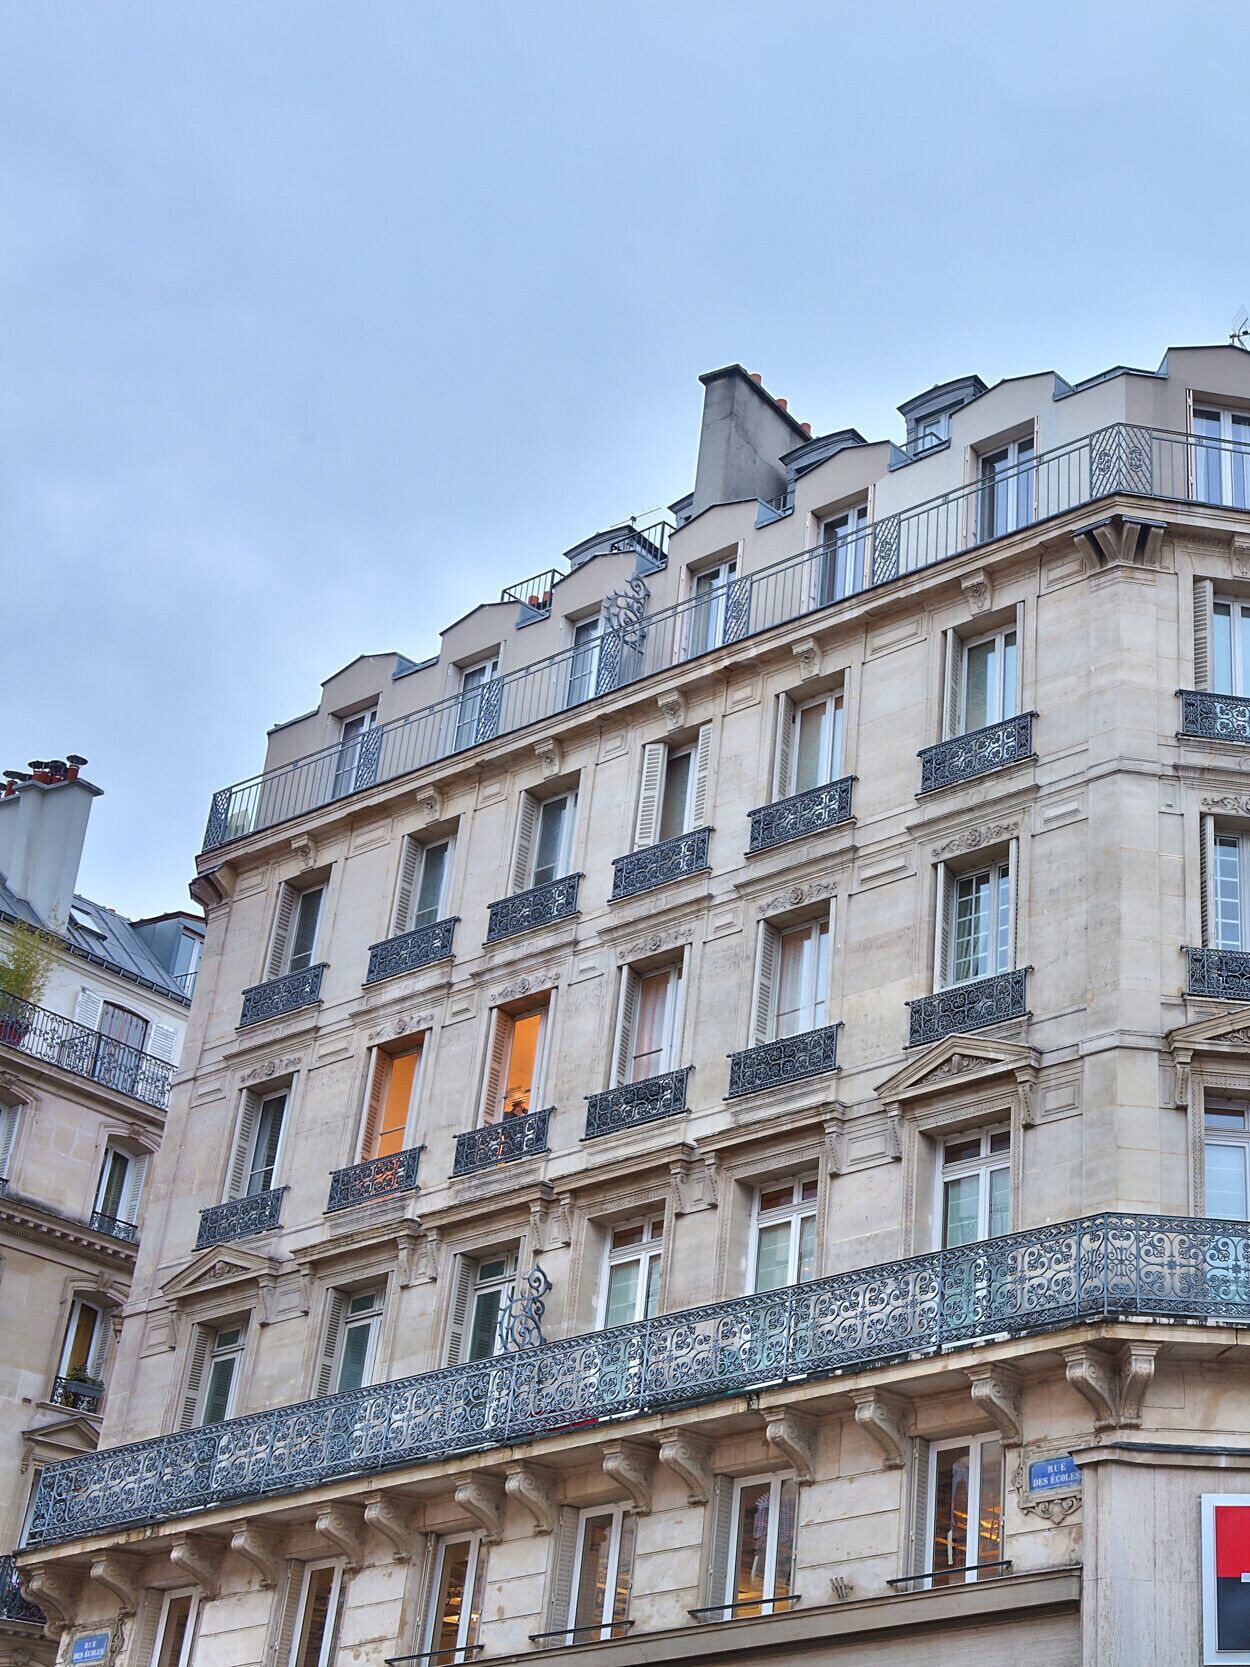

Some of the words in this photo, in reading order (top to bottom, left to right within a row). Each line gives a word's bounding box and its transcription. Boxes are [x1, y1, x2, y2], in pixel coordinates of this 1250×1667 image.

[1047, 1463, 1066, 1473] RUE
[1033, 1477, 1048, 1487] DES
[1050, 1472, 1080, 1484] ÉCOLES
